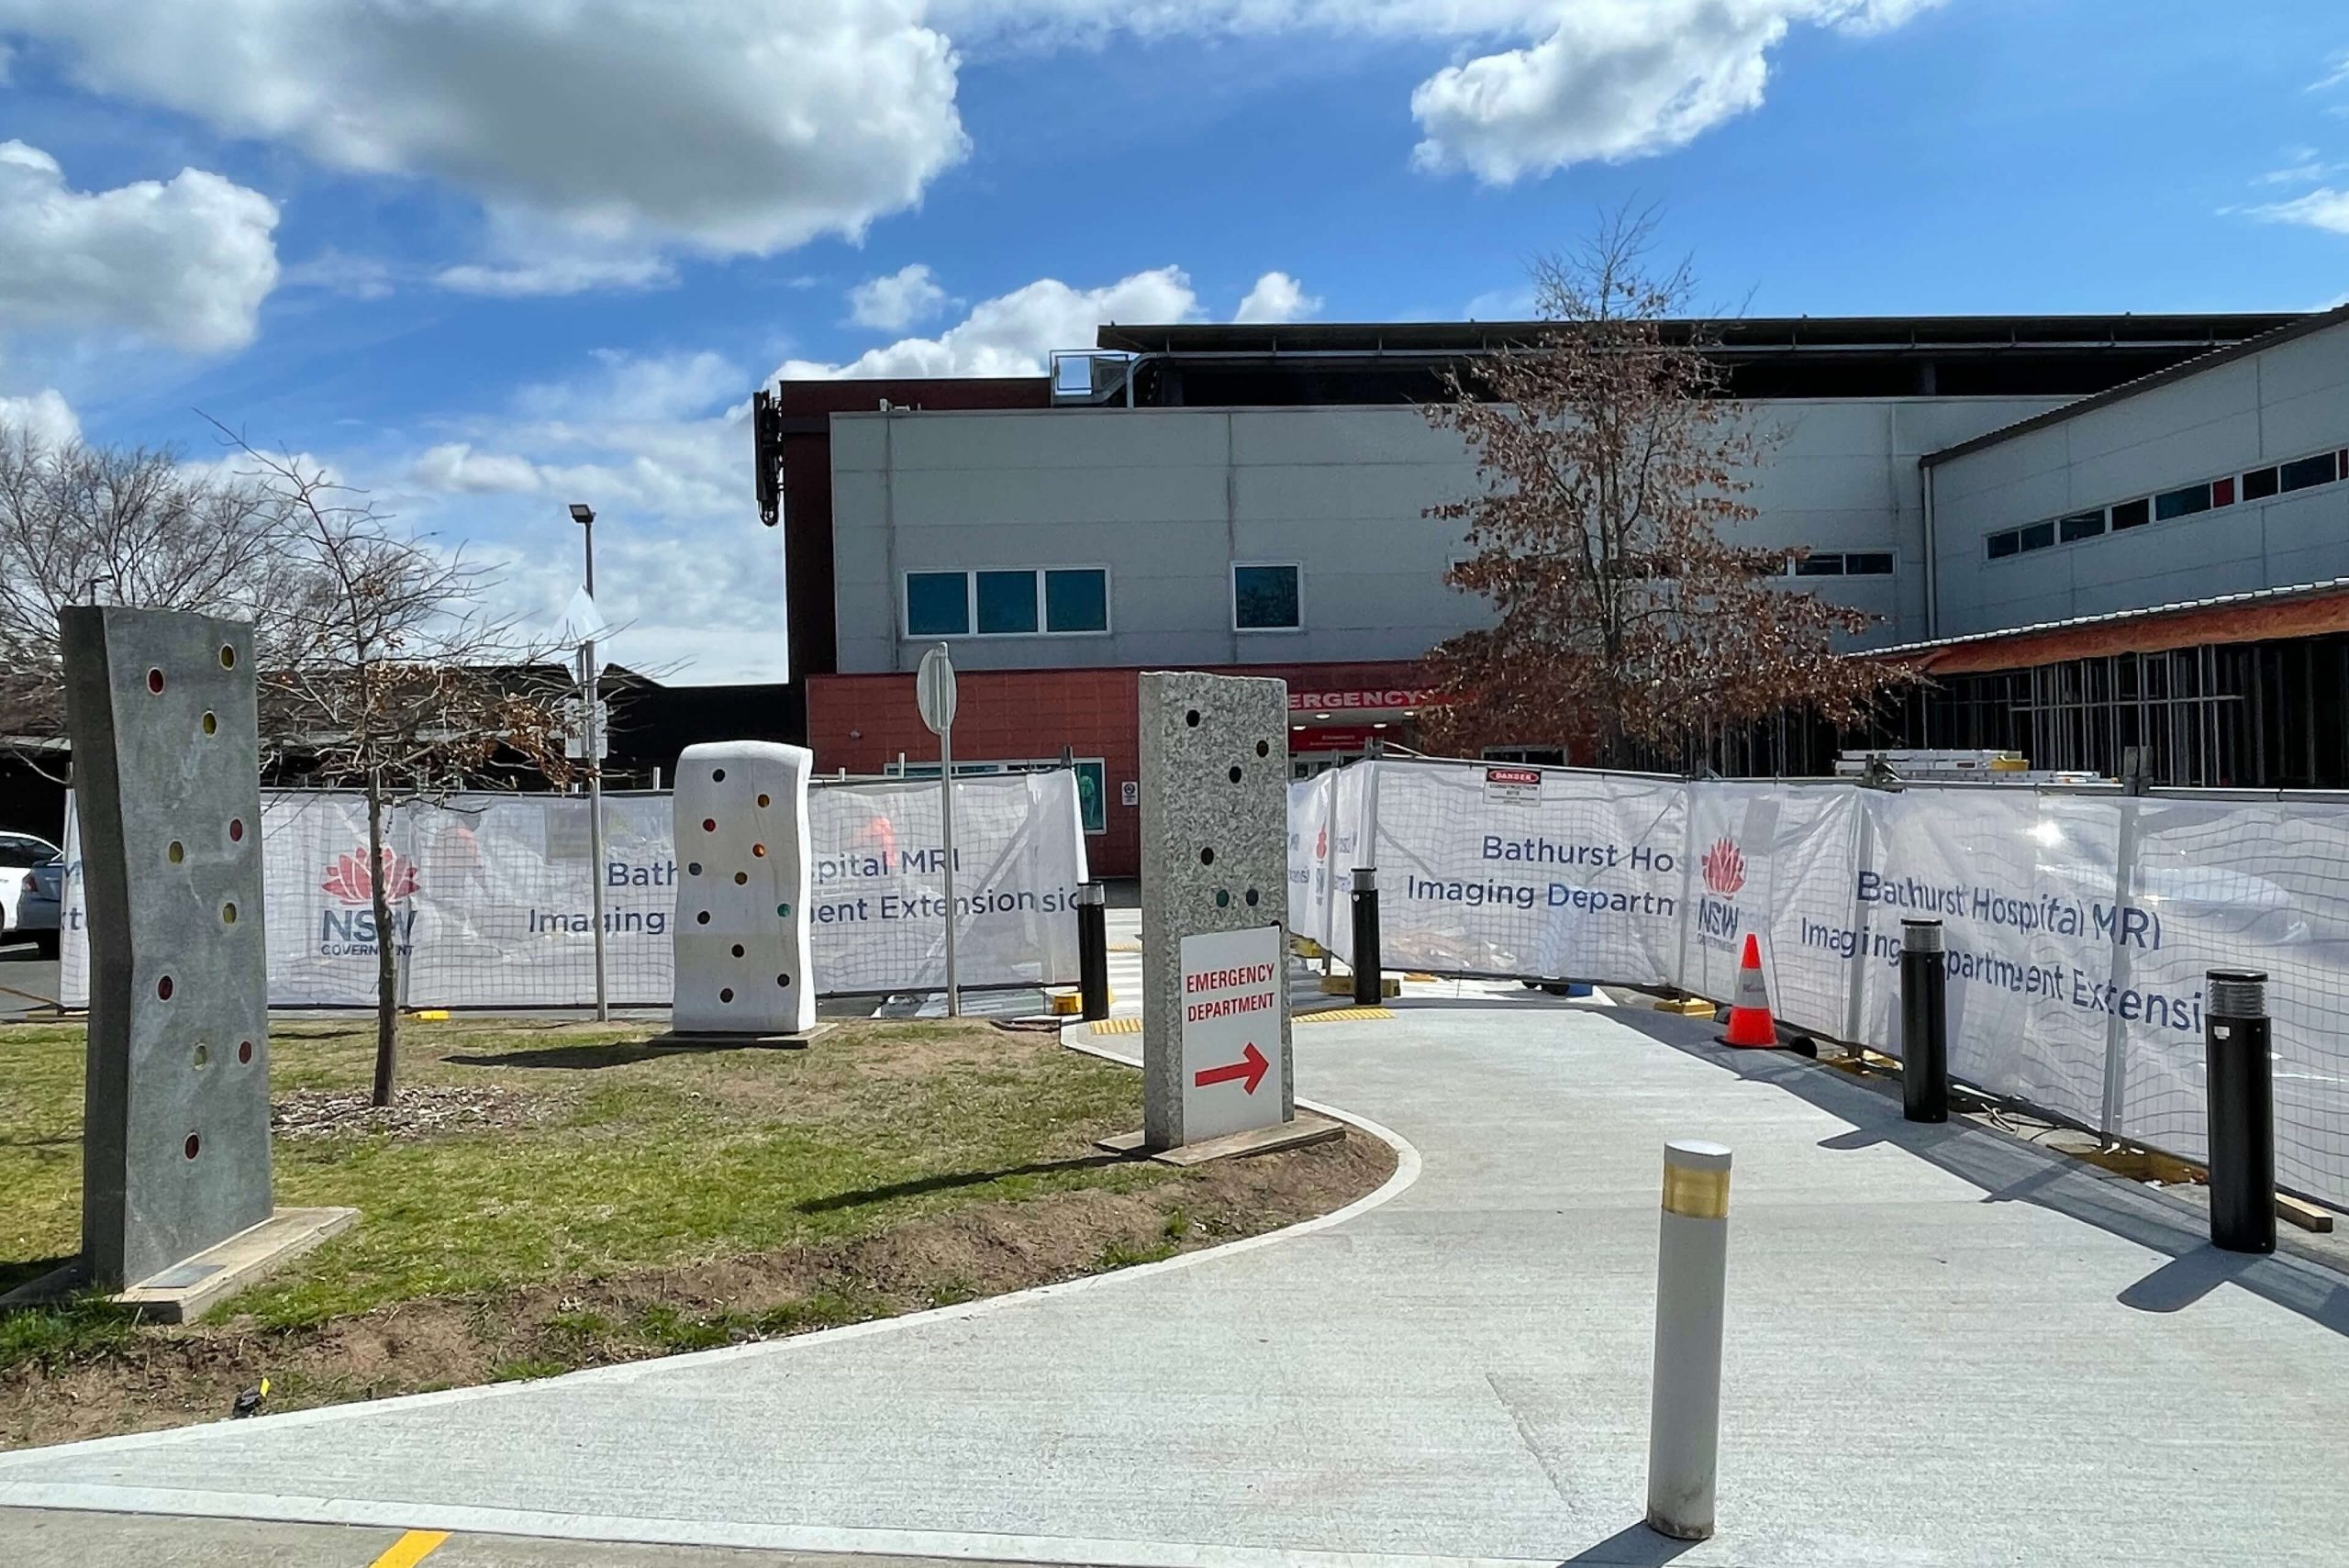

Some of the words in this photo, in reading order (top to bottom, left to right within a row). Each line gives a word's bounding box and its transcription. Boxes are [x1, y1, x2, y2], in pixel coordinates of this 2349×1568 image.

[1288, 690, 1421, 708] ERGENCY
[1495, 772, 1531, 781] DANGER
[811, 850, 888, 884] pital
[901, 848, 960, 873] MRI
[1482, 835, 1618, 867] Bathurst
[881, 888, 1034, 920] Extension
[1408, 874, 1535, 910] Imaging
[1698, 895, 1740, 940] NSW
[1857, 870, 1968, 917] Bathurst
[1972, 886, 2085, 937] Hospital
[2093, 903, 2160, 951] MRI
[321, 943, 415, 956] GOVERNNT
[1186, 962, 1275, 994] EMERGENCY
[1802, 917, 1901, 967] Imaging
[2072, 968, 2203, 1034] Extensi
[1187, 992, 1275, 1023] DEPARTMENT
